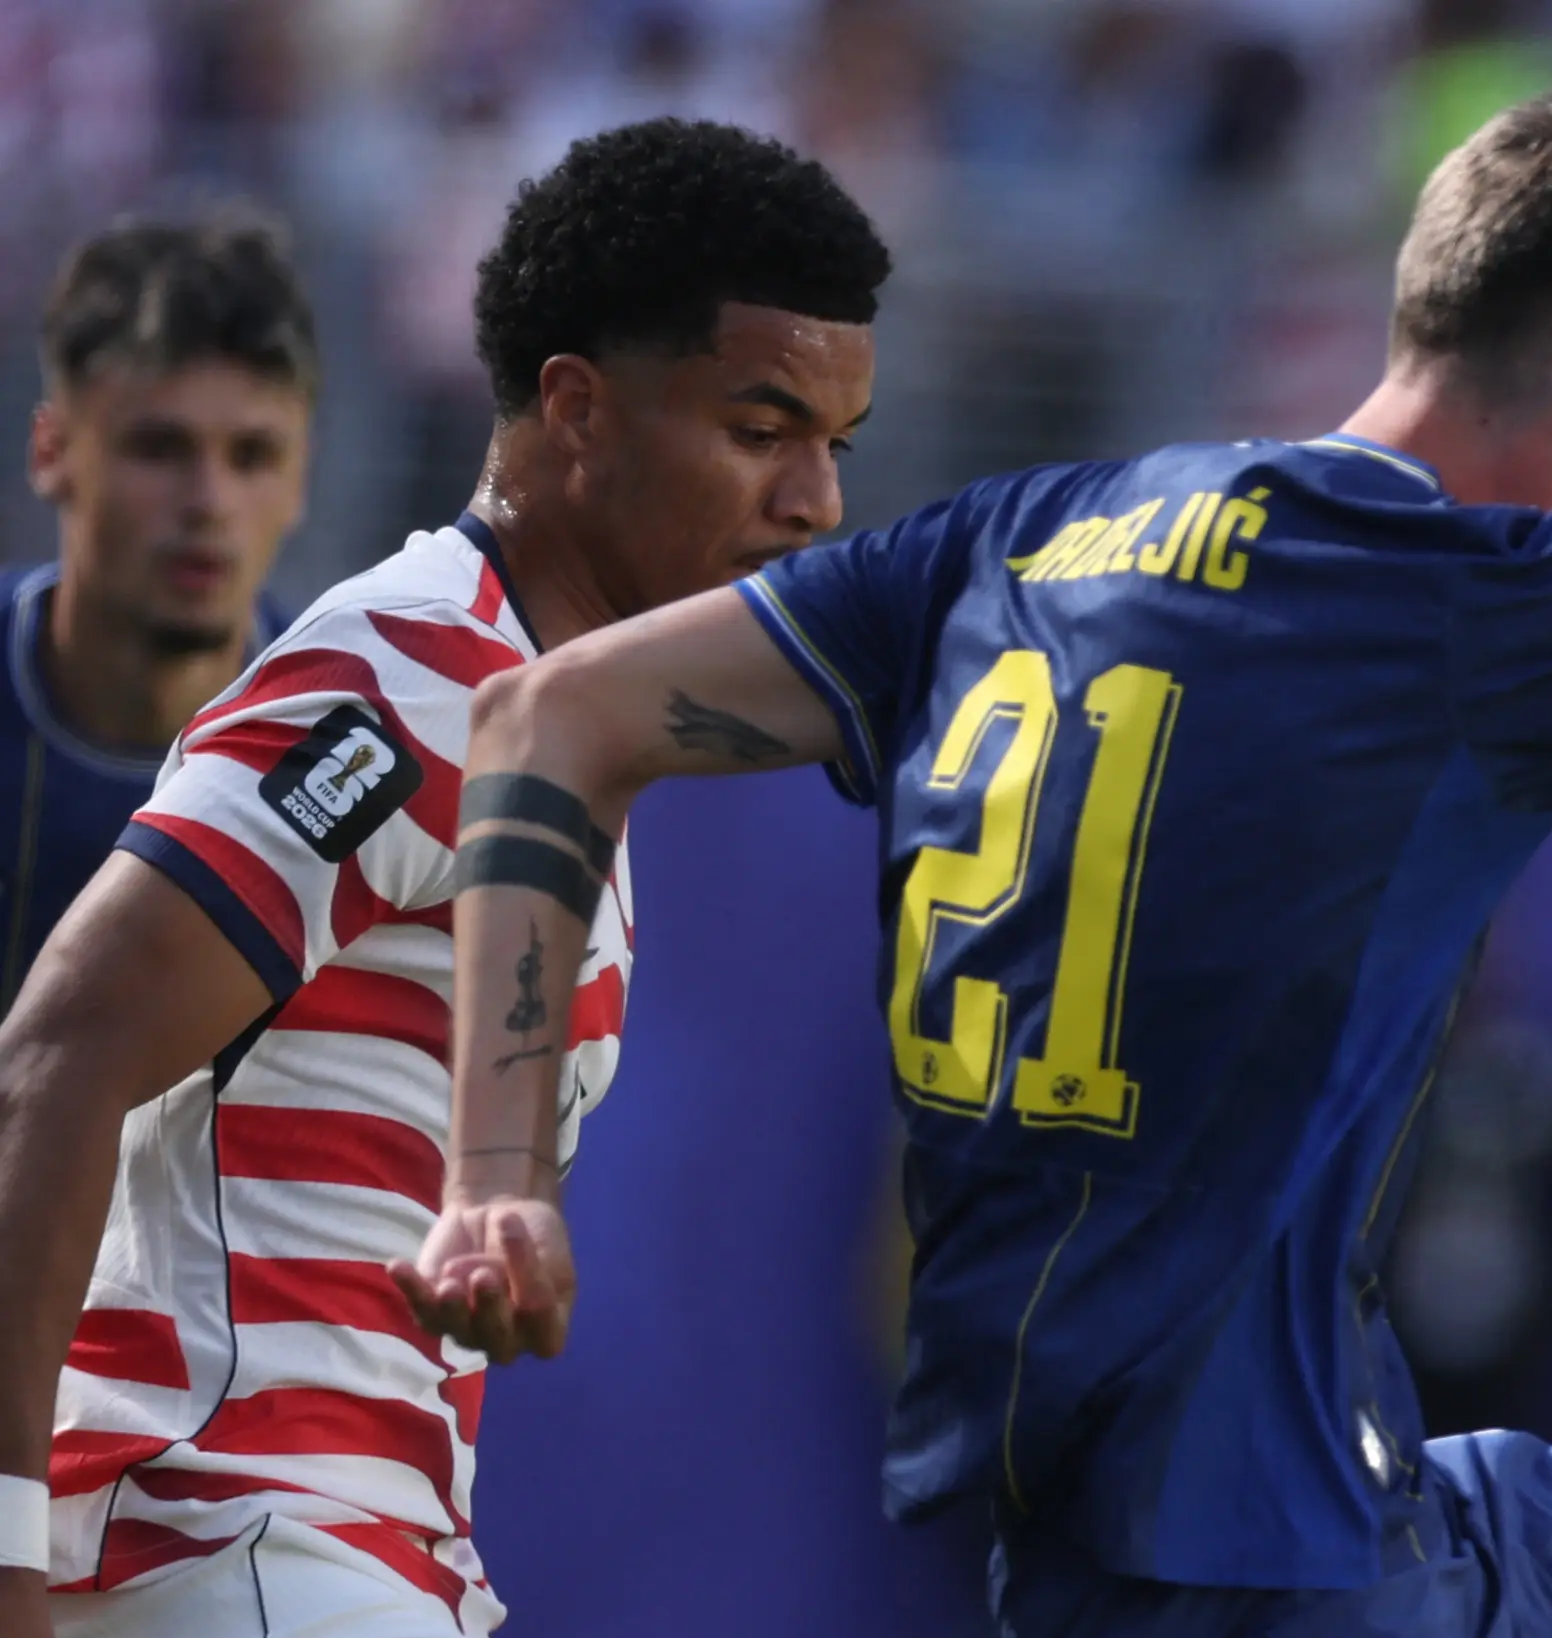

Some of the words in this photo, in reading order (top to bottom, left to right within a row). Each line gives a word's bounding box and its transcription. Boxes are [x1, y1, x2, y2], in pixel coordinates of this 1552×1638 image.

[292, 786, 320, 815] WORLD
[317, 810, 336, 829] CUP
[316, 782, 339, 805] FIFA
[280, 794, 328, 840] 2026
[888, 650, 1182, 1138] 21
